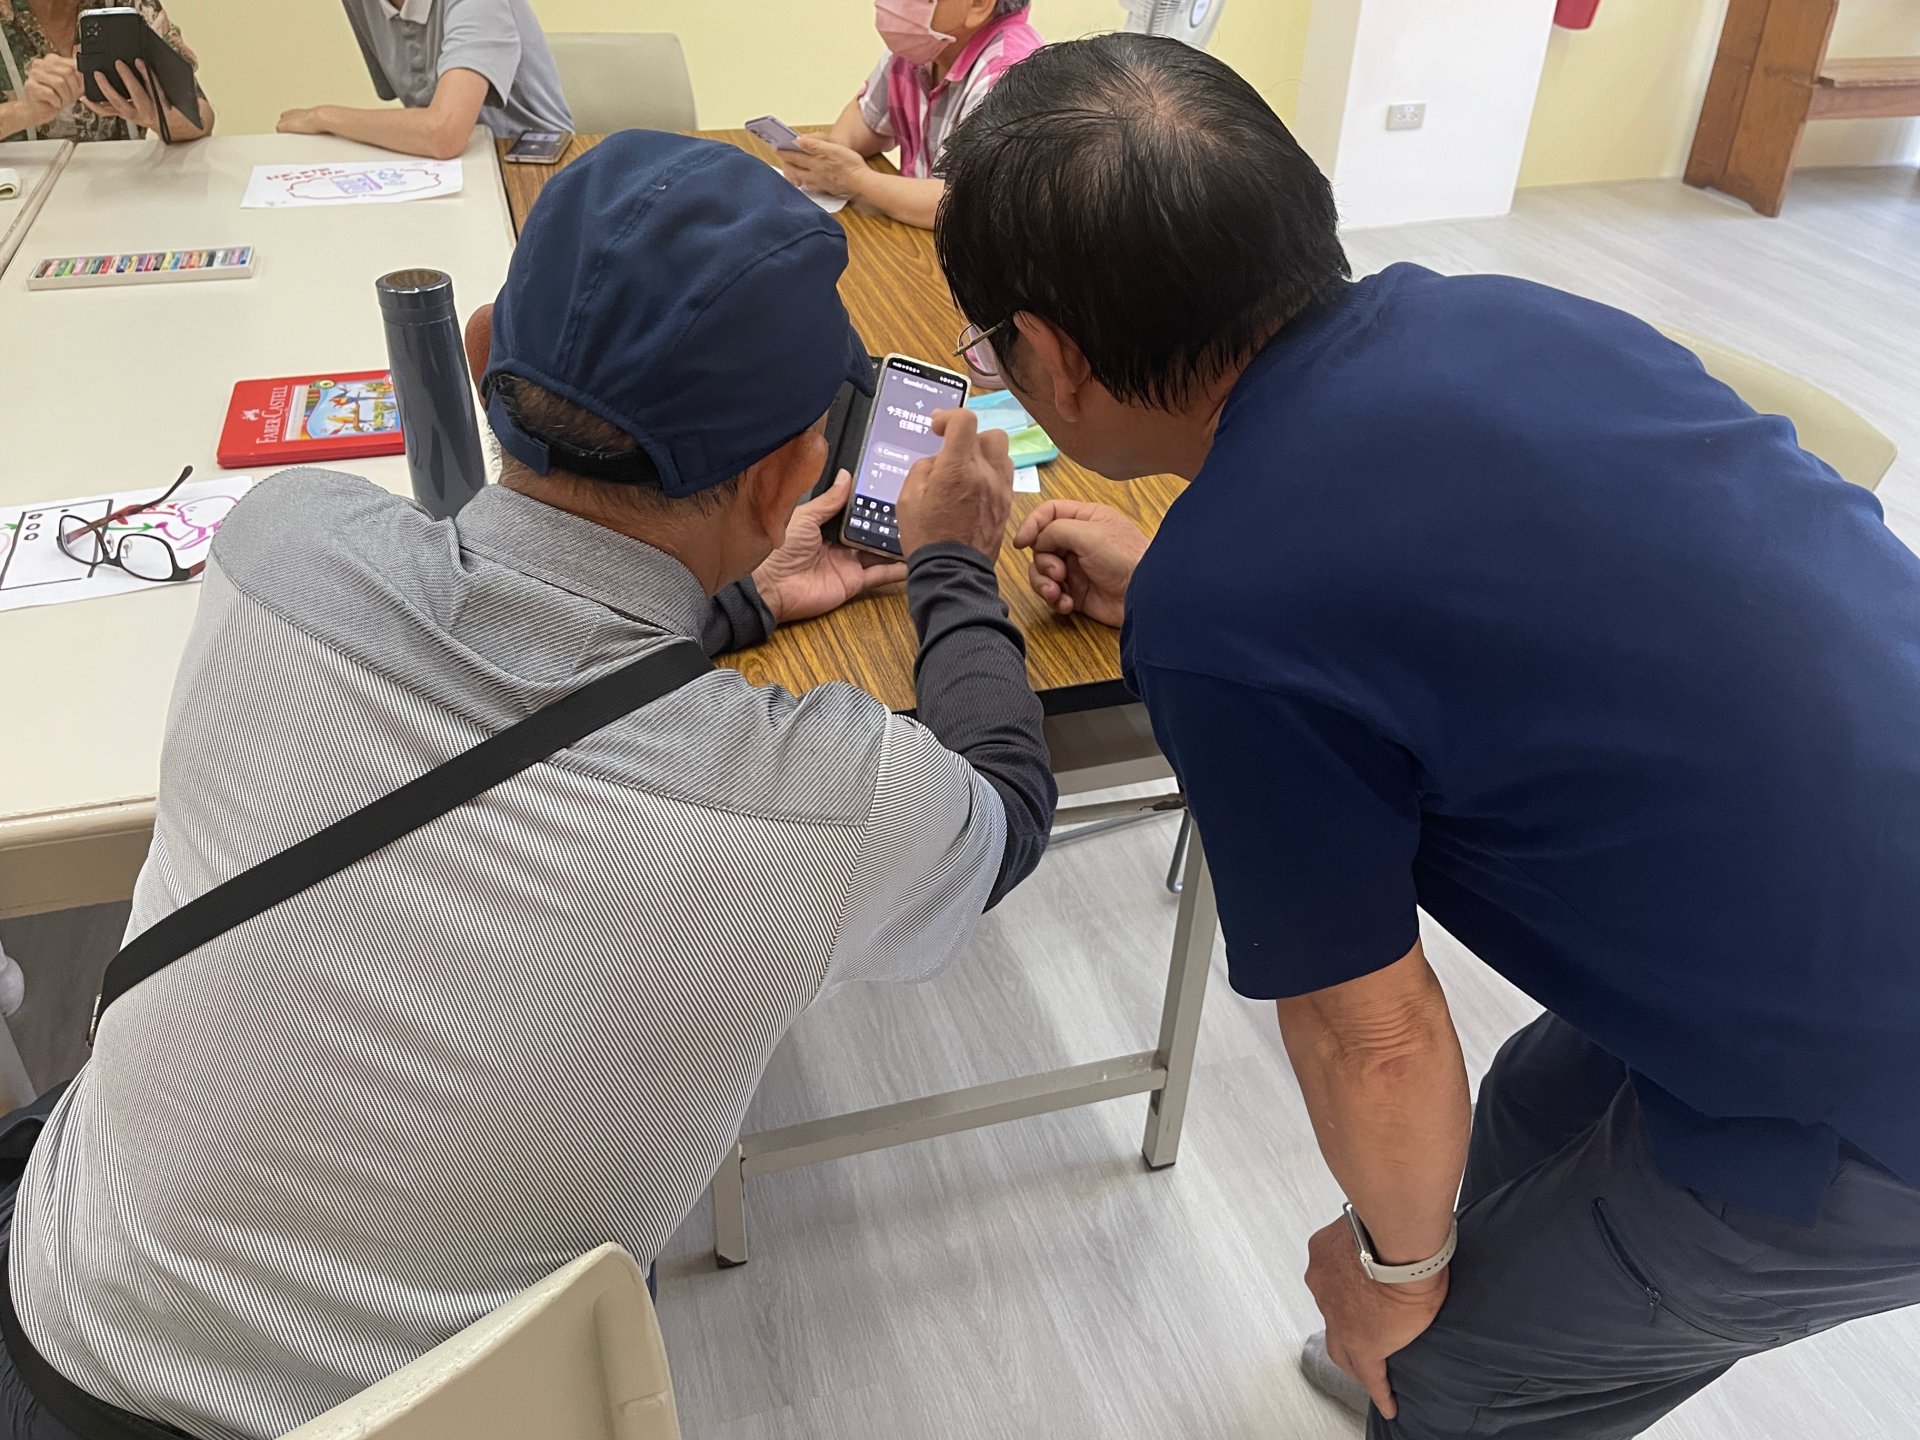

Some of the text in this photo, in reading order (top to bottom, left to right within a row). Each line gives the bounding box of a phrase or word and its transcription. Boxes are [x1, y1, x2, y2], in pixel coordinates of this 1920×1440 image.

[256, 385, 288, 444] FABER-CASTELL
[887, 405, 932, 427] 今天有什麼
